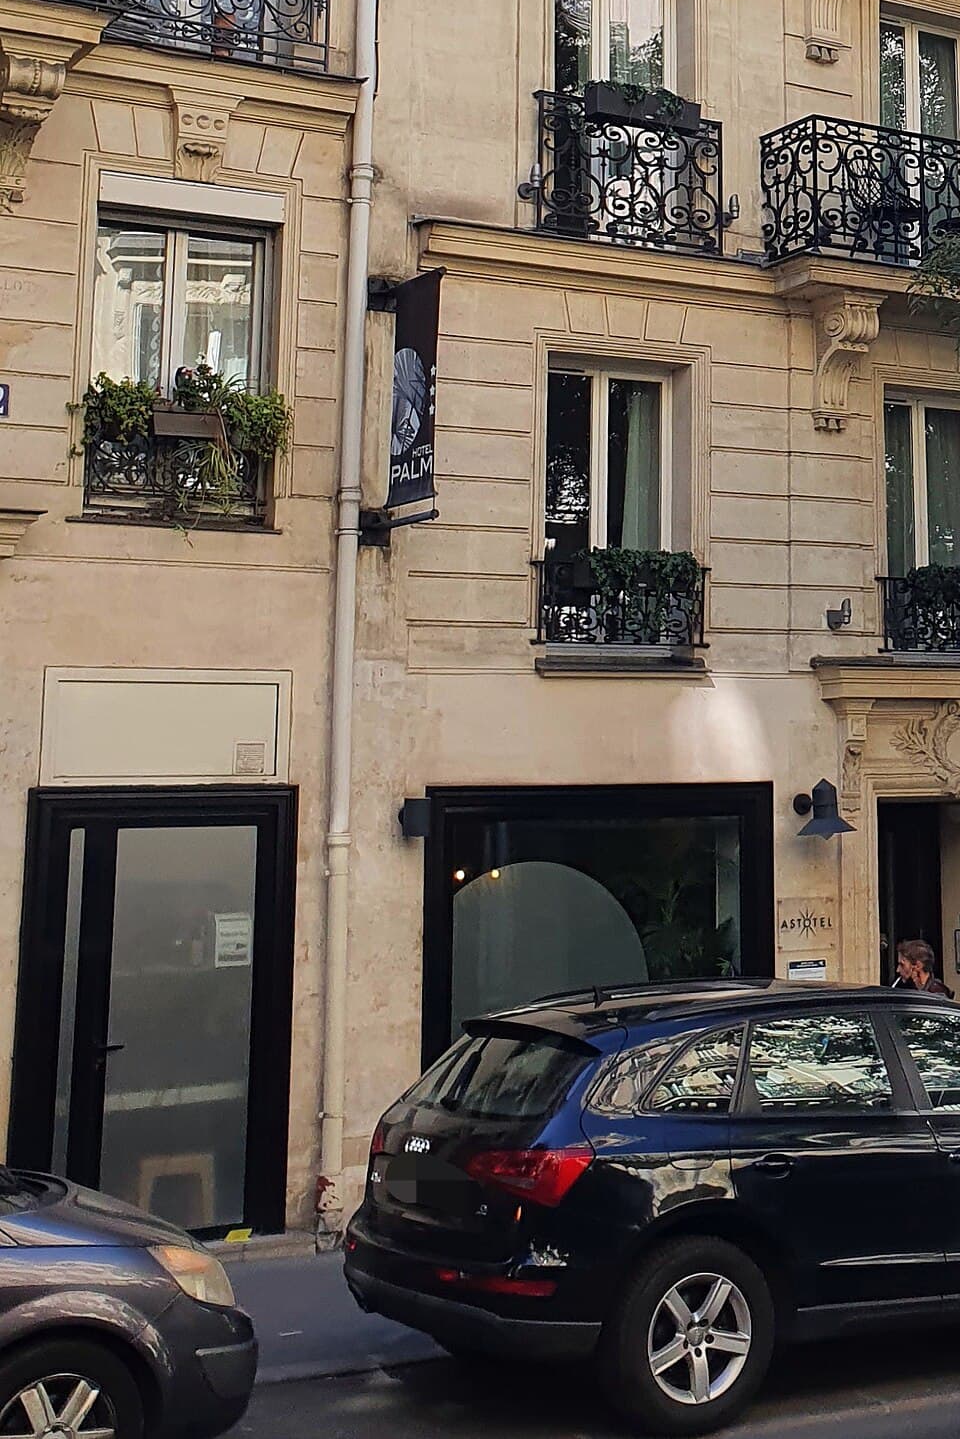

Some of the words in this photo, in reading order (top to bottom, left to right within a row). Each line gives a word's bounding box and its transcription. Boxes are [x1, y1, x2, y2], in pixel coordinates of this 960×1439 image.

[412, 443, 433, 458] HOTEL
[391, 455, 433, 485] PALM
[780, 914, 833, 931] ASTOTEL
